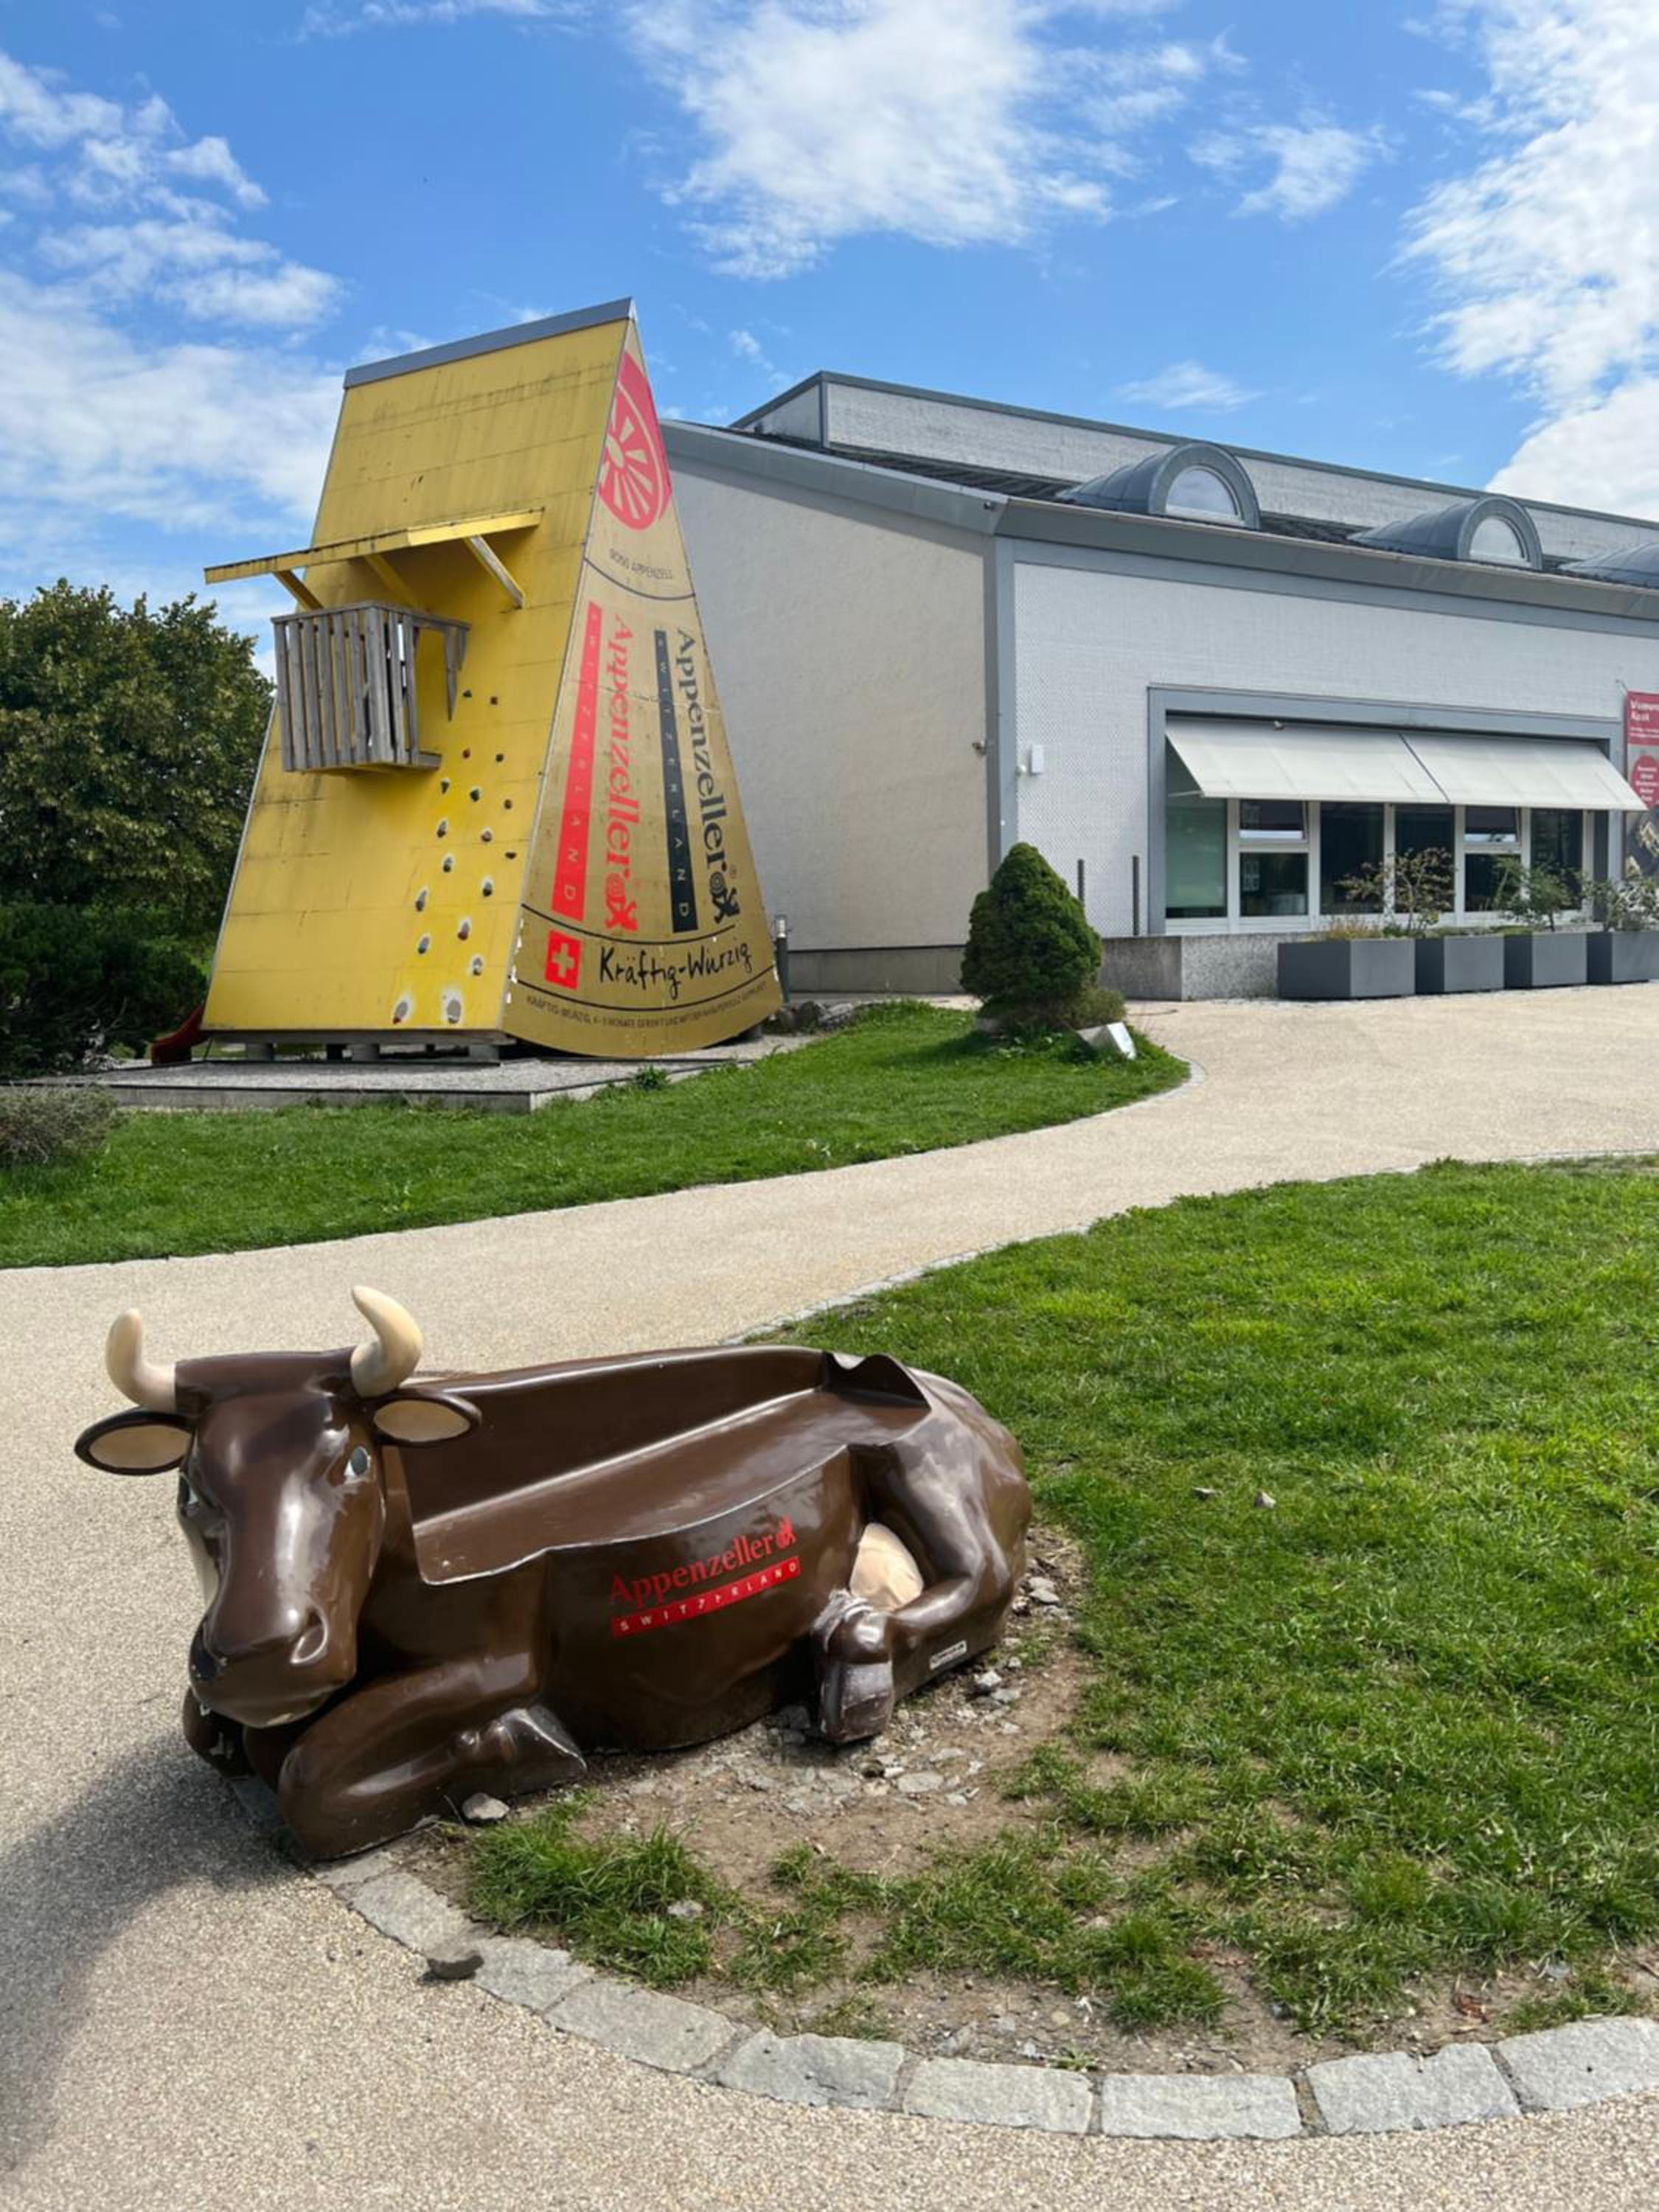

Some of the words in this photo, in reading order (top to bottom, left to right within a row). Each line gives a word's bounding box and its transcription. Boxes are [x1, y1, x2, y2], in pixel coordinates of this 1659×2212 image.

[605, 613, 639, 878] Appenzeller
[675, 628, 728, 872] Appenzeller
[609, 1533, 773, 1608] Appenzeller
